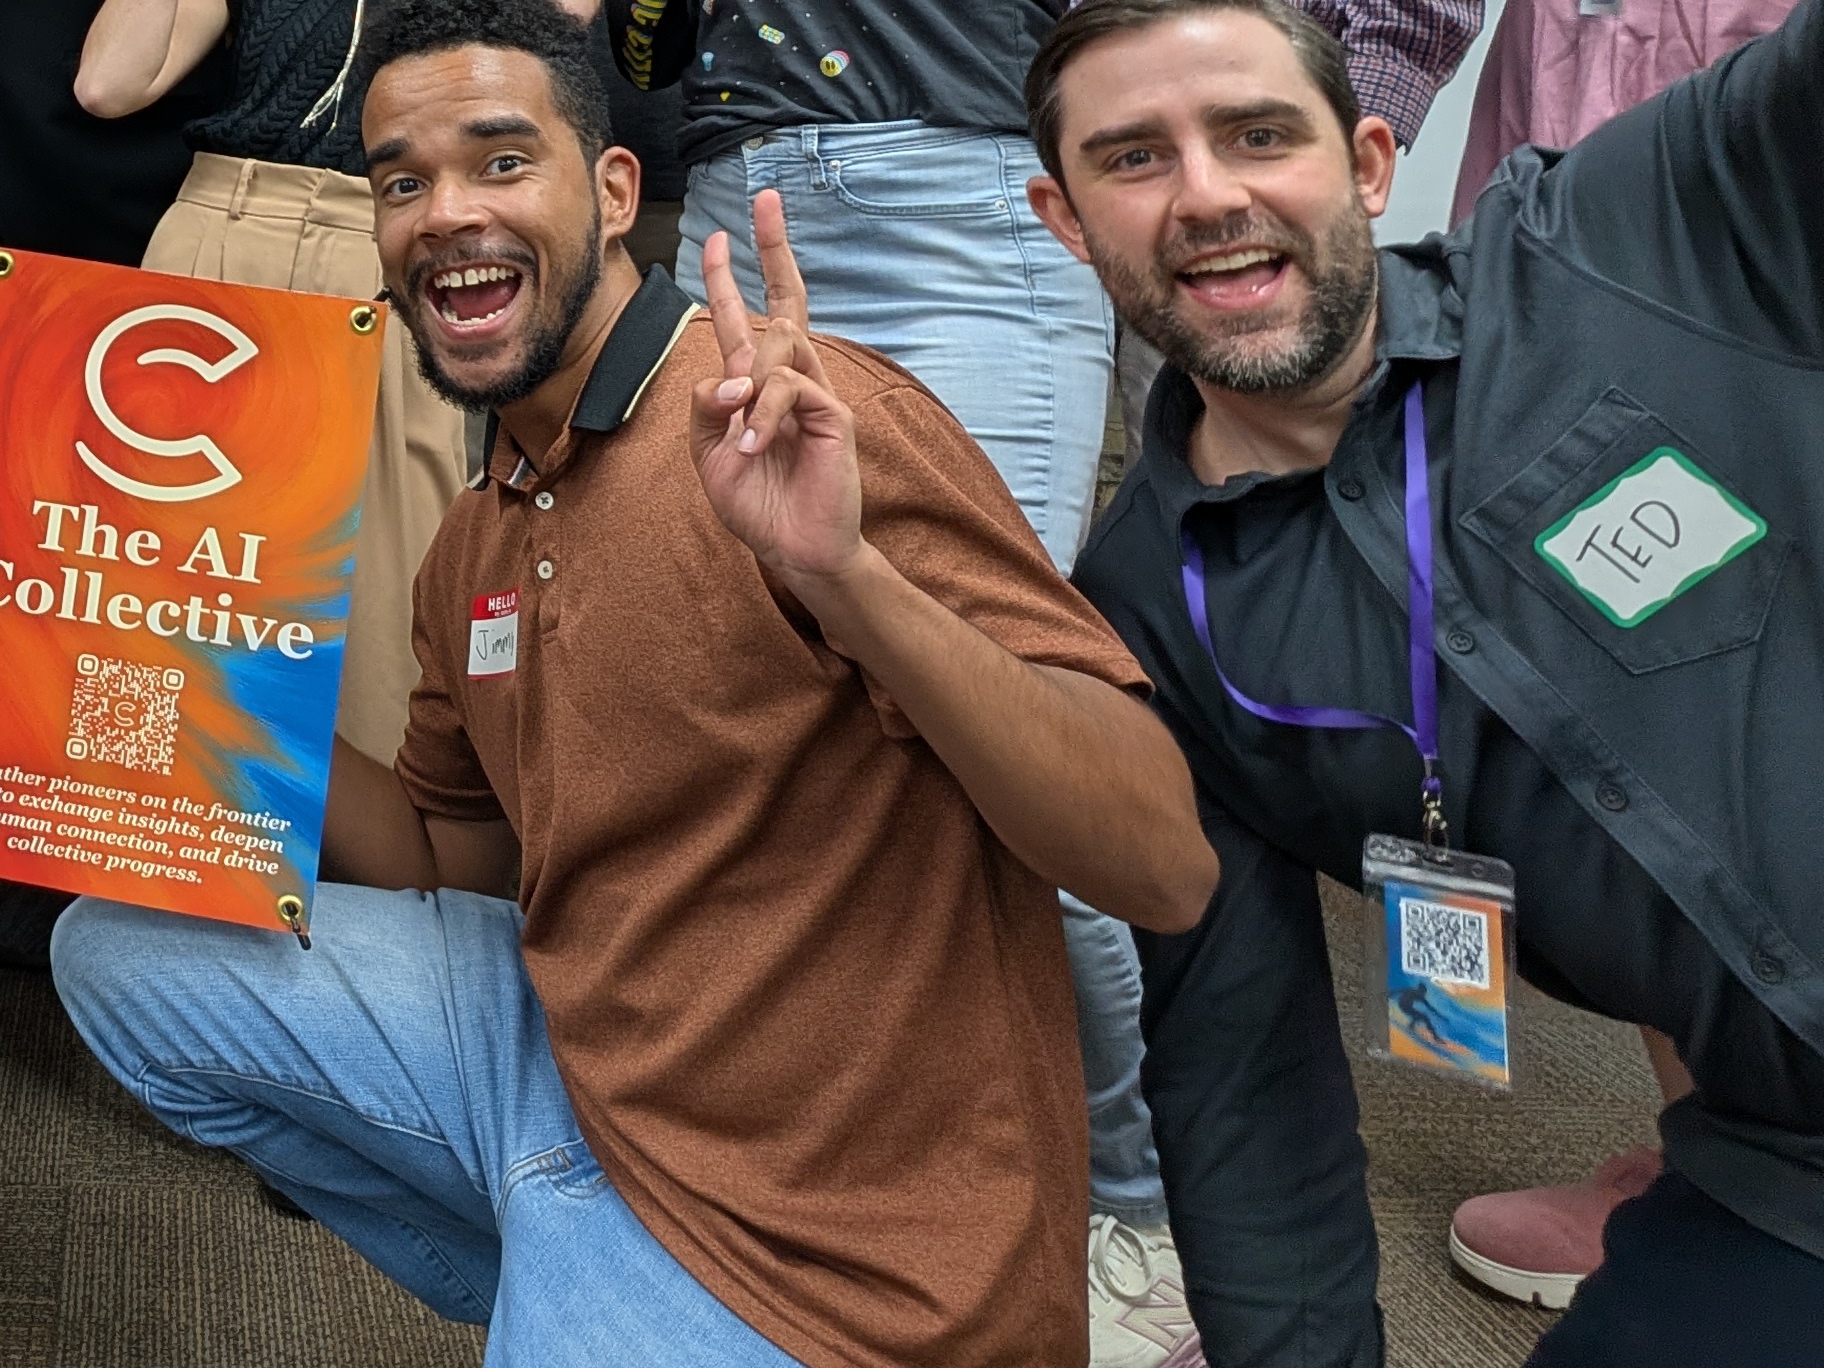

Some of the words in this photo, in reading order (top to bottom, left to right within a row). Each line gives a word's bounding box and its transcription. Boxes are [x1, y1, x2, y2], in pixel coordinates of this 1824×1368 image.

[32, 499, 161, 566] The
[177, 527, 267, 584] AI
[1576, 500, 1680, 583] TED
[487, 592, 516, 611] HELLO
[18, 794, 114, 823] exchange
[117, 807, 205, 842] insights,
[210, 825, 284, 854] deepen
[47, 775, 137, 804] pioneers
[140, 793, 168, 810] on
[172, 797, 205, 816] the
[203, 802, 292, 832] frontier
[7, 835, 103, 865] collective
[104, 854, 204, 884] progress.
[56, 823, 174, 859] connection,
[179, 845, 222, 865] and
[223, 850, 280, 875] drive
